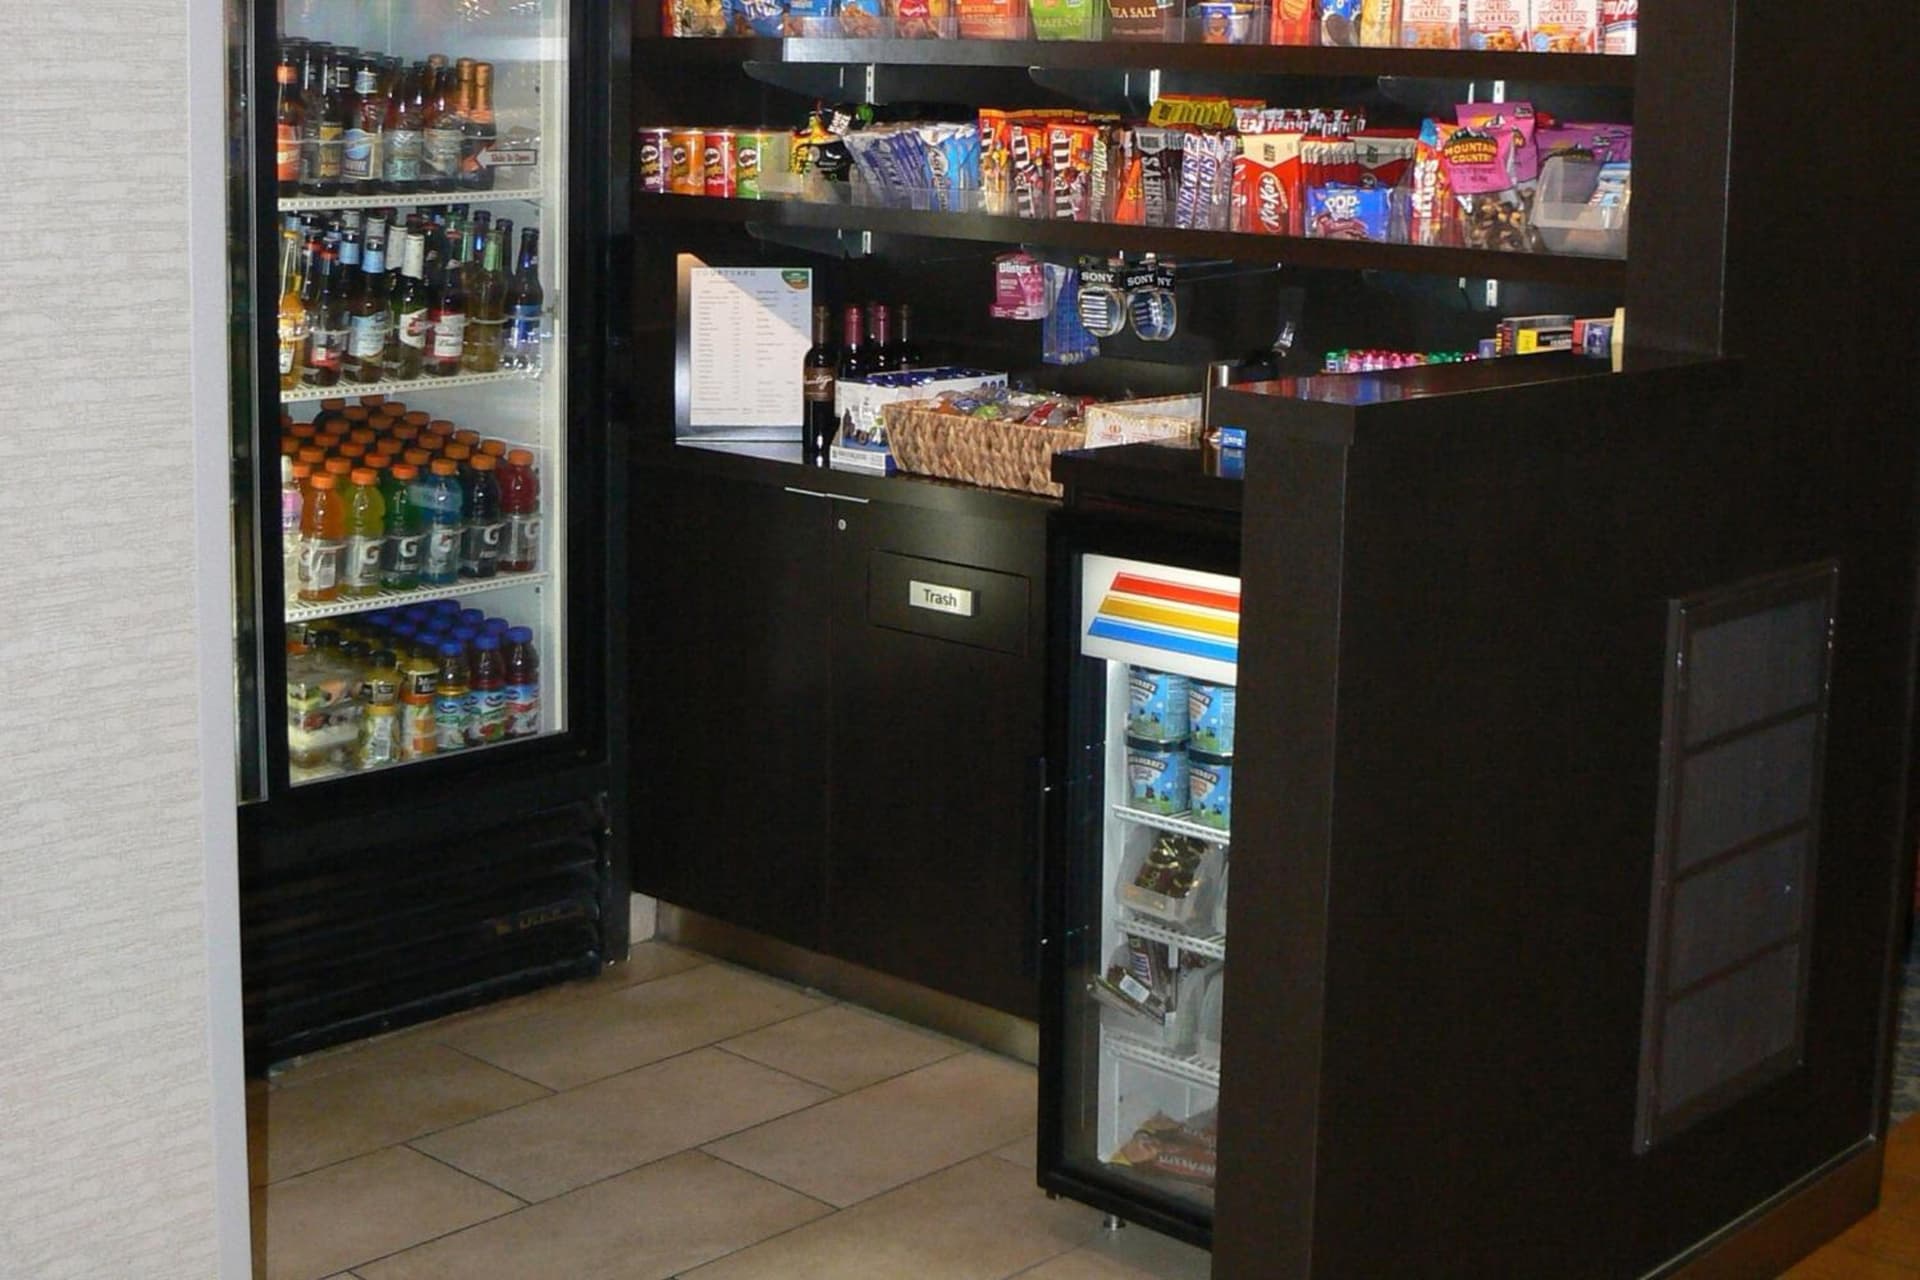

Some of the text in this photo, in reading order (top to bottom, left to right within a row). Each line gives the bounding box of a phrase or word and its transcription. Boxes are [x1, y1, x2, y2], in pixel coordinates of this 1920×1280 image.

[1130, 7, 1157, 18] SALT
[1444, 142, 1497, 155] MOUNTAIN
[1450, 154, 1495, 164] COUNTRY
[1175, 155, 1199, 226] SNICKERS
[1081, 271, 1114, 283] SONY
[1127, 274, 1154, 287] SONY
[400, 539, 417, 558] G
[923, 588, 958, 608] Trash
